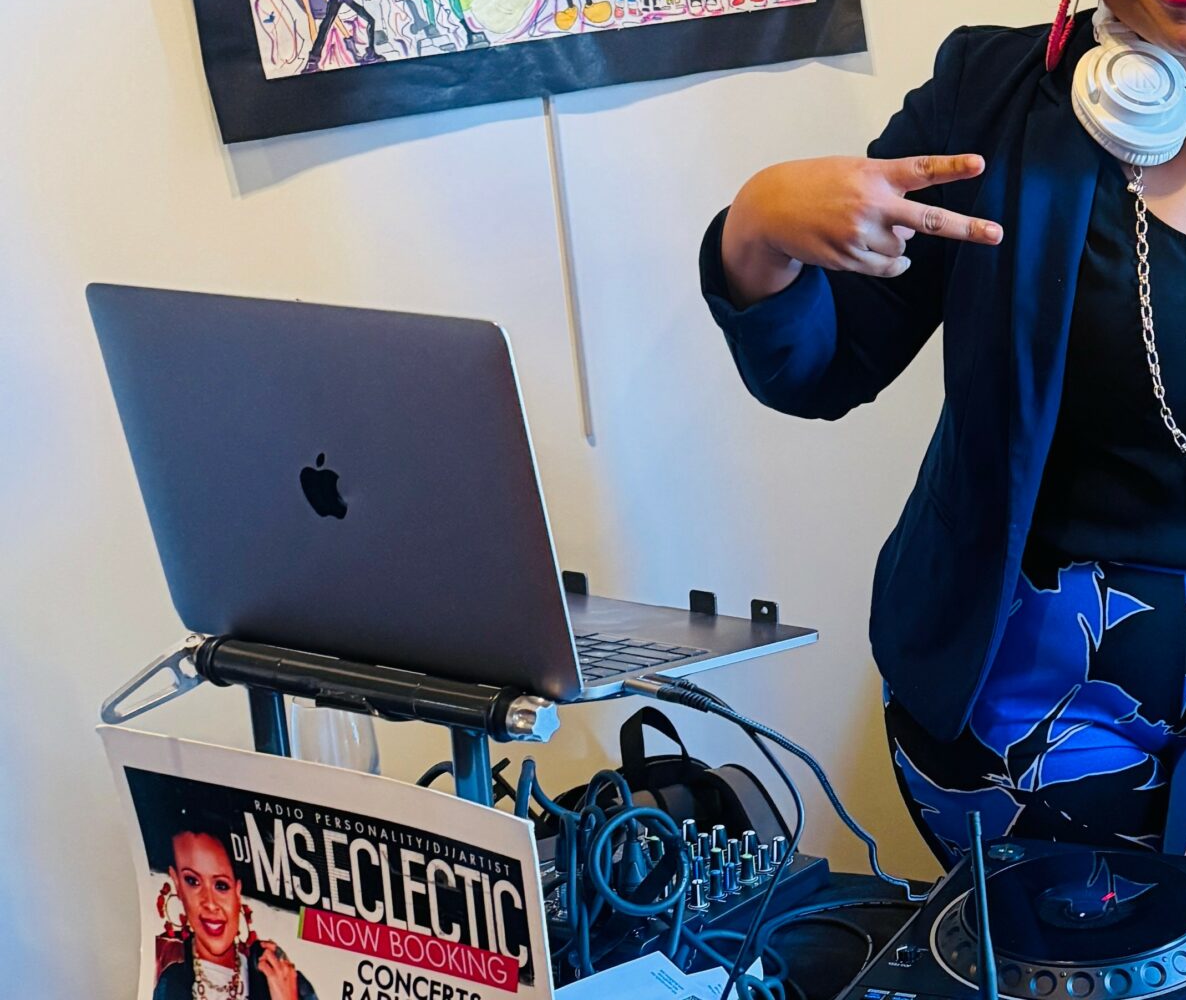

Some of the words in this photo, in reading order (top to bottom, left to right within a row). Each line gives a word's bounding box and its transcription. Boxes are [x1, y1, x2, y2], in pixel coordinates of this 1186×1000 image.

[254, 800, 303, 820] RADIO
[231, 832, 251, 863] DJ
[316, 914, 380, 952] NOW
[389, 930, 507, 983] BOOKING
